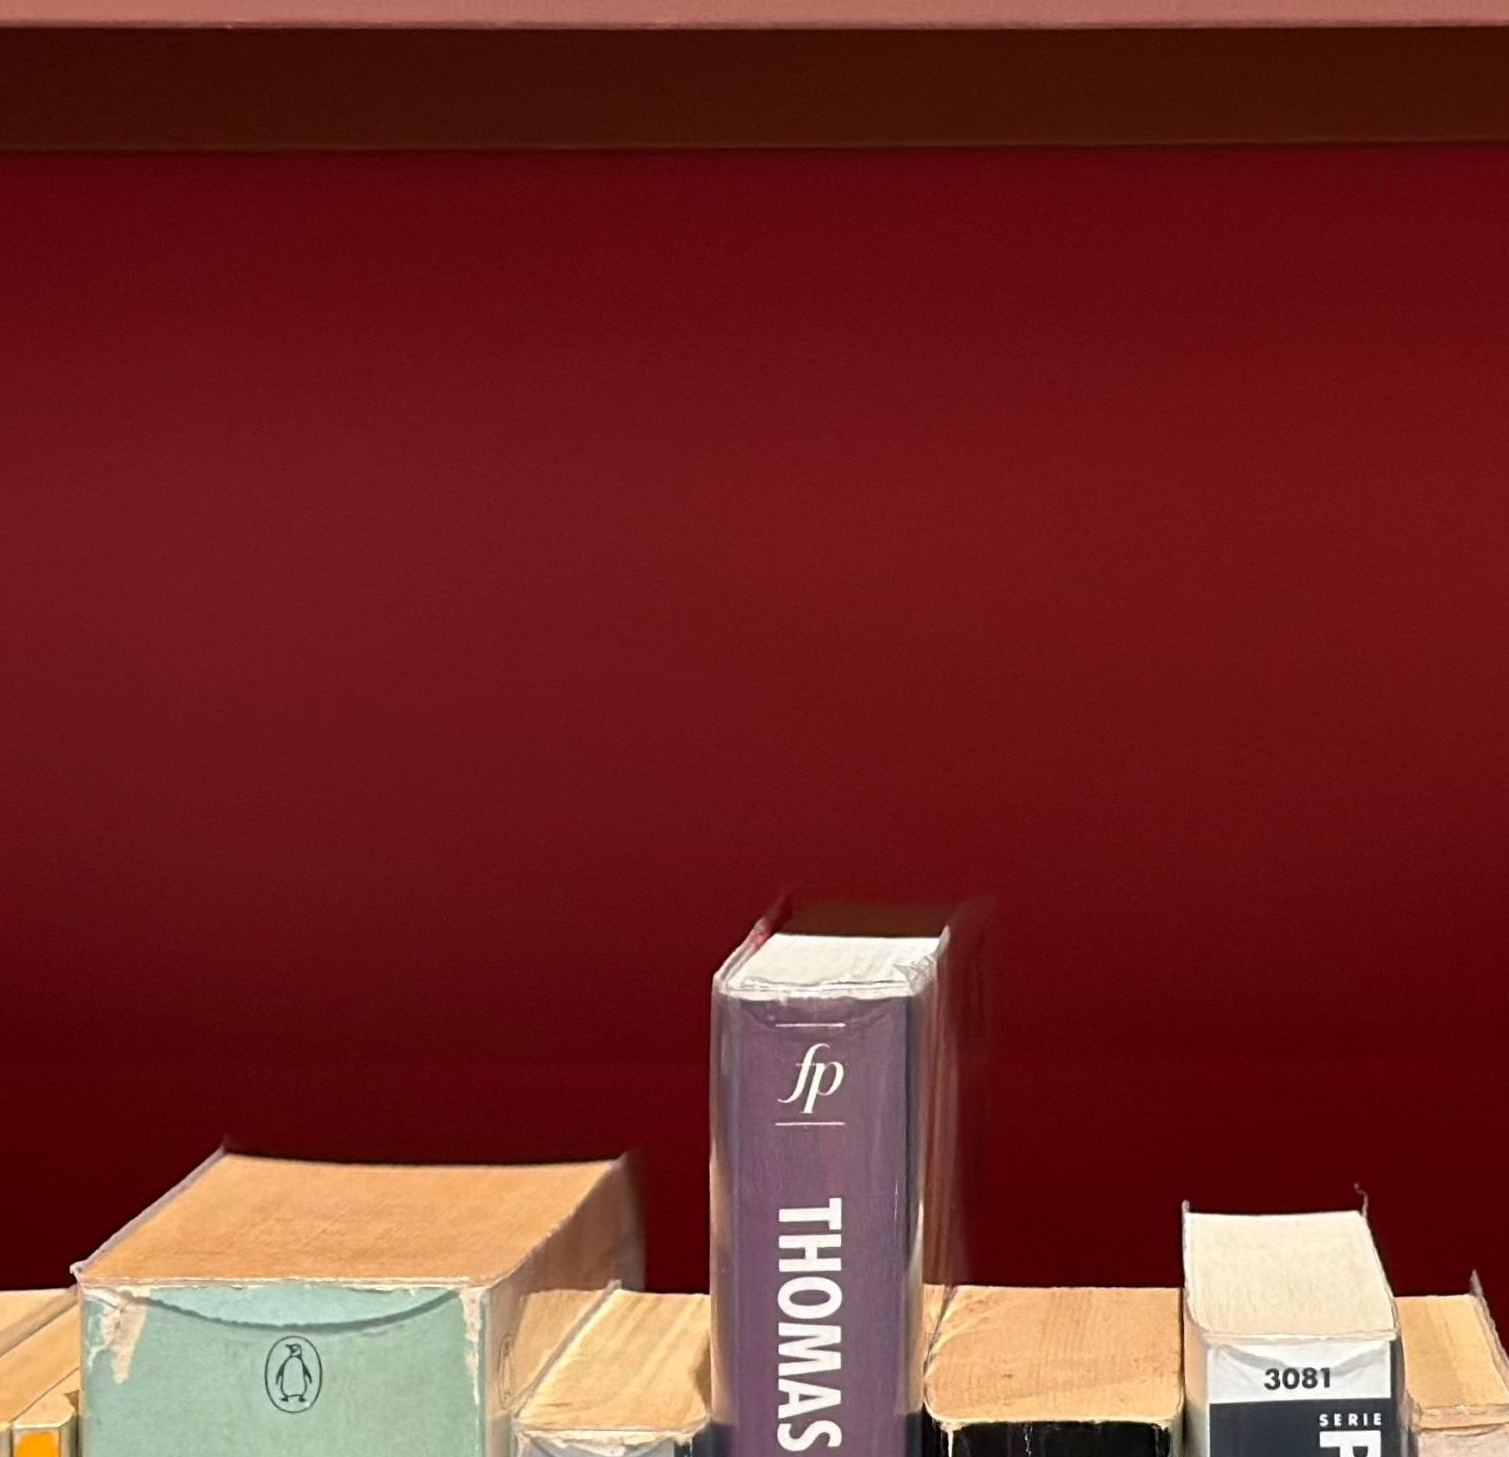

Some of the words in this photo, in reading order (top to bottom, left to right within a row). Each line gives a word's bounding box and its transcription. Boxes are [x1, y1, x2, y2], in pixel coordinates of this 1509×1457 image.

[777, 1198, 842, 1452] THOMAS
[1263, 1367, 1332, 1391] 3081
[1319, 1413, 1383, 1426] SERIE
